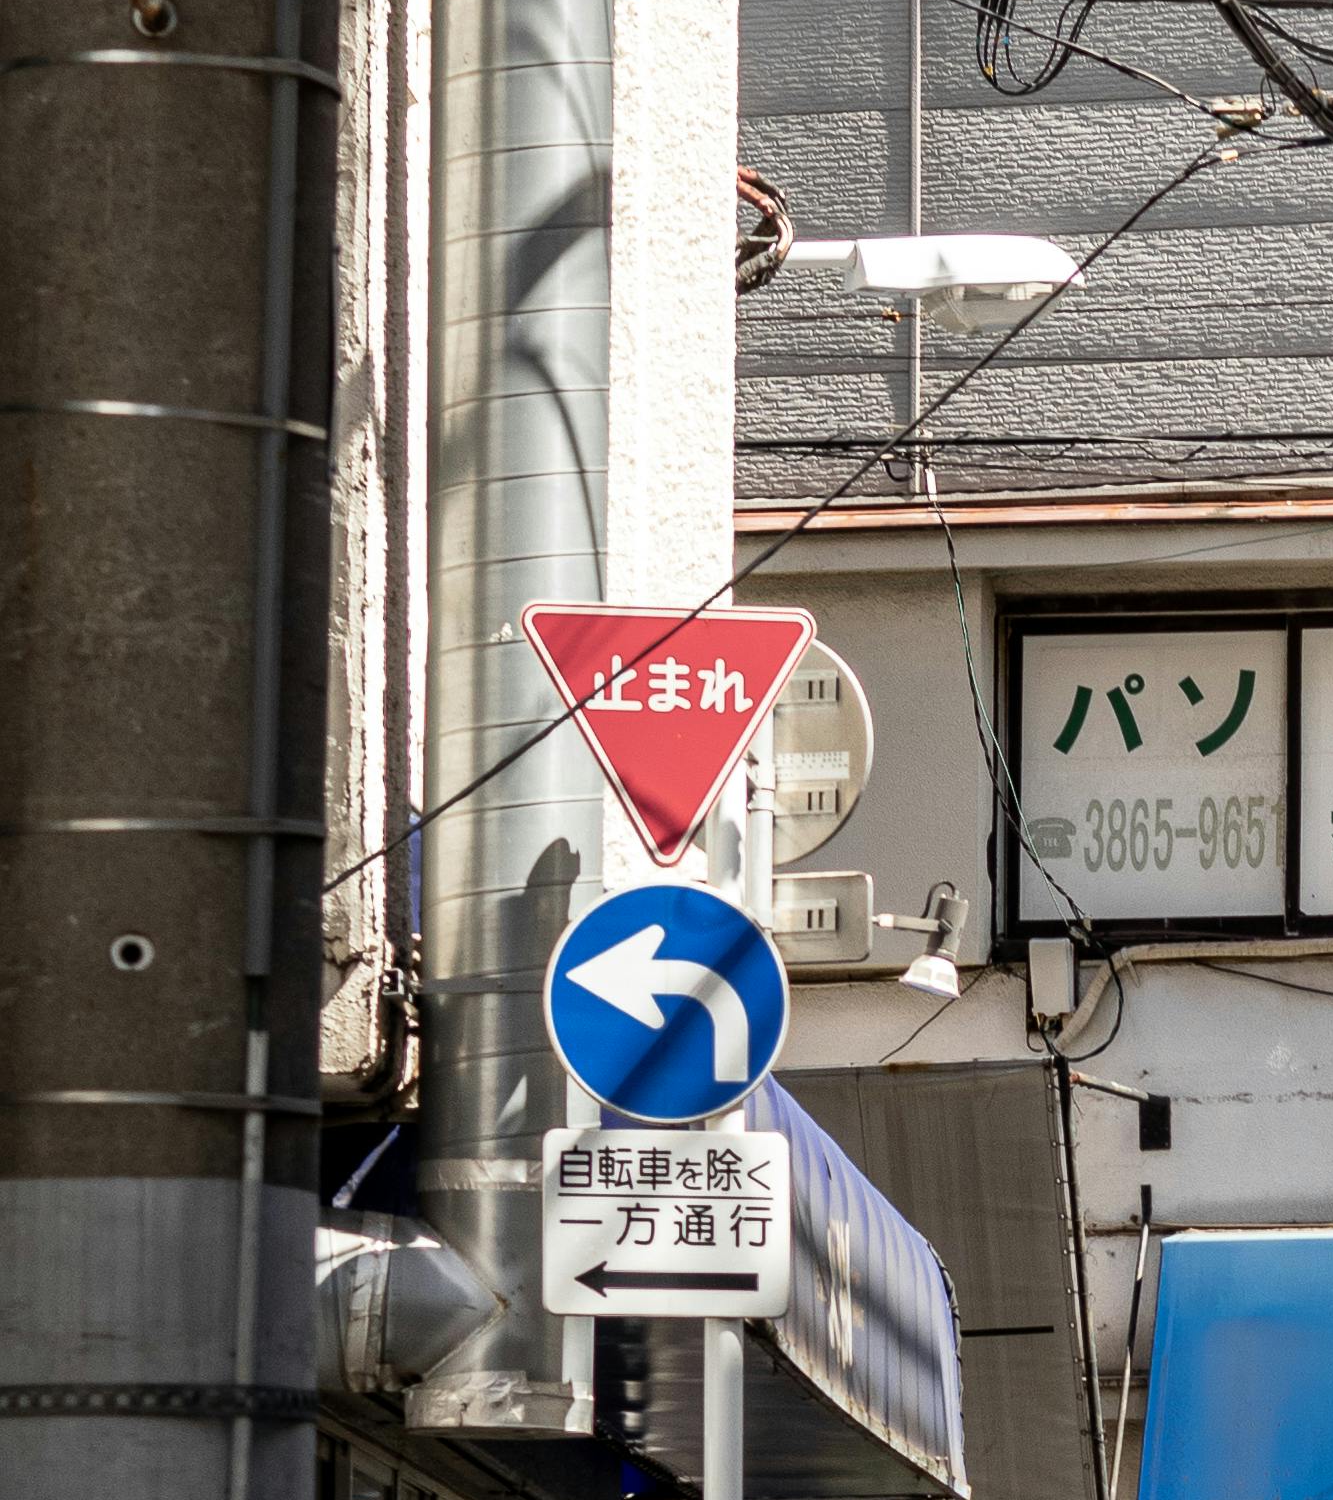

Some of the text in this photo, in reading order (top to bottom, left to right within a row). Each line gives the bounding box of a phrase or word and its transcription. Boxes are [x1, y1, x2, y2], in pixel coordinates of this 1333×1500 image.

[586, 655, 754, 714] 止まれ
[559, 1146, 772, 1191] 自転車を除く
[558, 1203, 774, 1249] 一方通行
